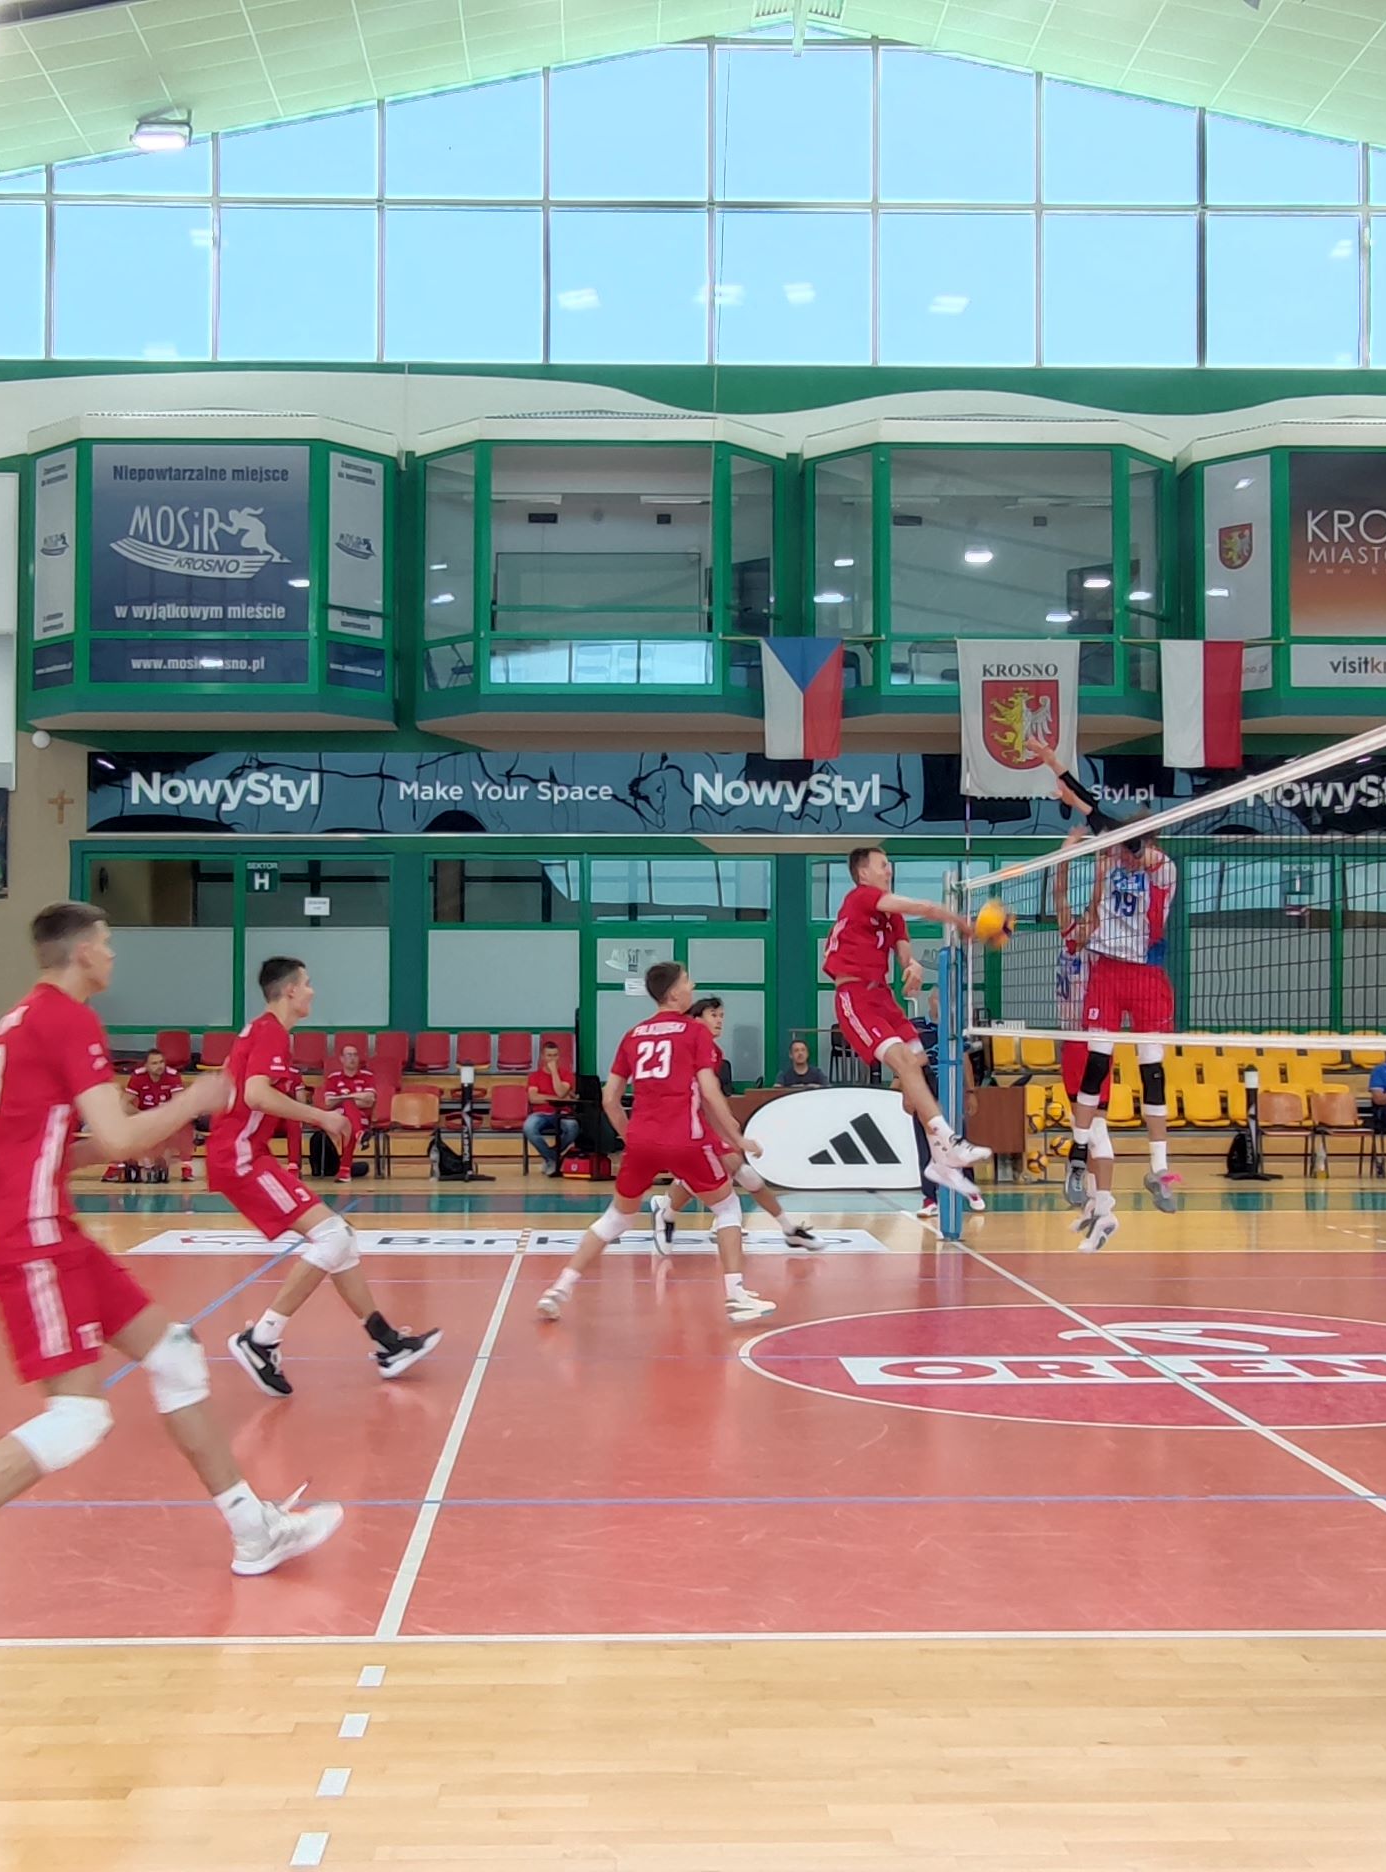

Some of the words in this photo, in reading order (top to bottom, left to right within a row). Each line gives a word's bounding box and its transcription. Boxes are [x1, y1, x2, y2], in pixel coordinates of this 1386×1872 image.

[113, 465, 227, 483] Niepowtarzalne
[231, 466, 289, 483] miejsce
[173, 557, 240, 574] KROSNO
[114, 604, 128, 618] w
[132, 603, 223, 620] wyjątkowym
[227, 603, 286, 619] mieście
[131, 657, 265, 672] www.mosisno.pl
[982, 663, 1059, 678] KROSNO
[131, 771, 320, 812] NowyStyl
[399, 780, 464, 801] Make
[472, 781, 529, 801] Your
[537, 781, 613, 804] Space
[693, 773, 880, 812] NowyStyl
[254, 872, 269, 890] H
[635, 1040, 672, 1080] 23
[377, 1236, 582, 1246] Bank
